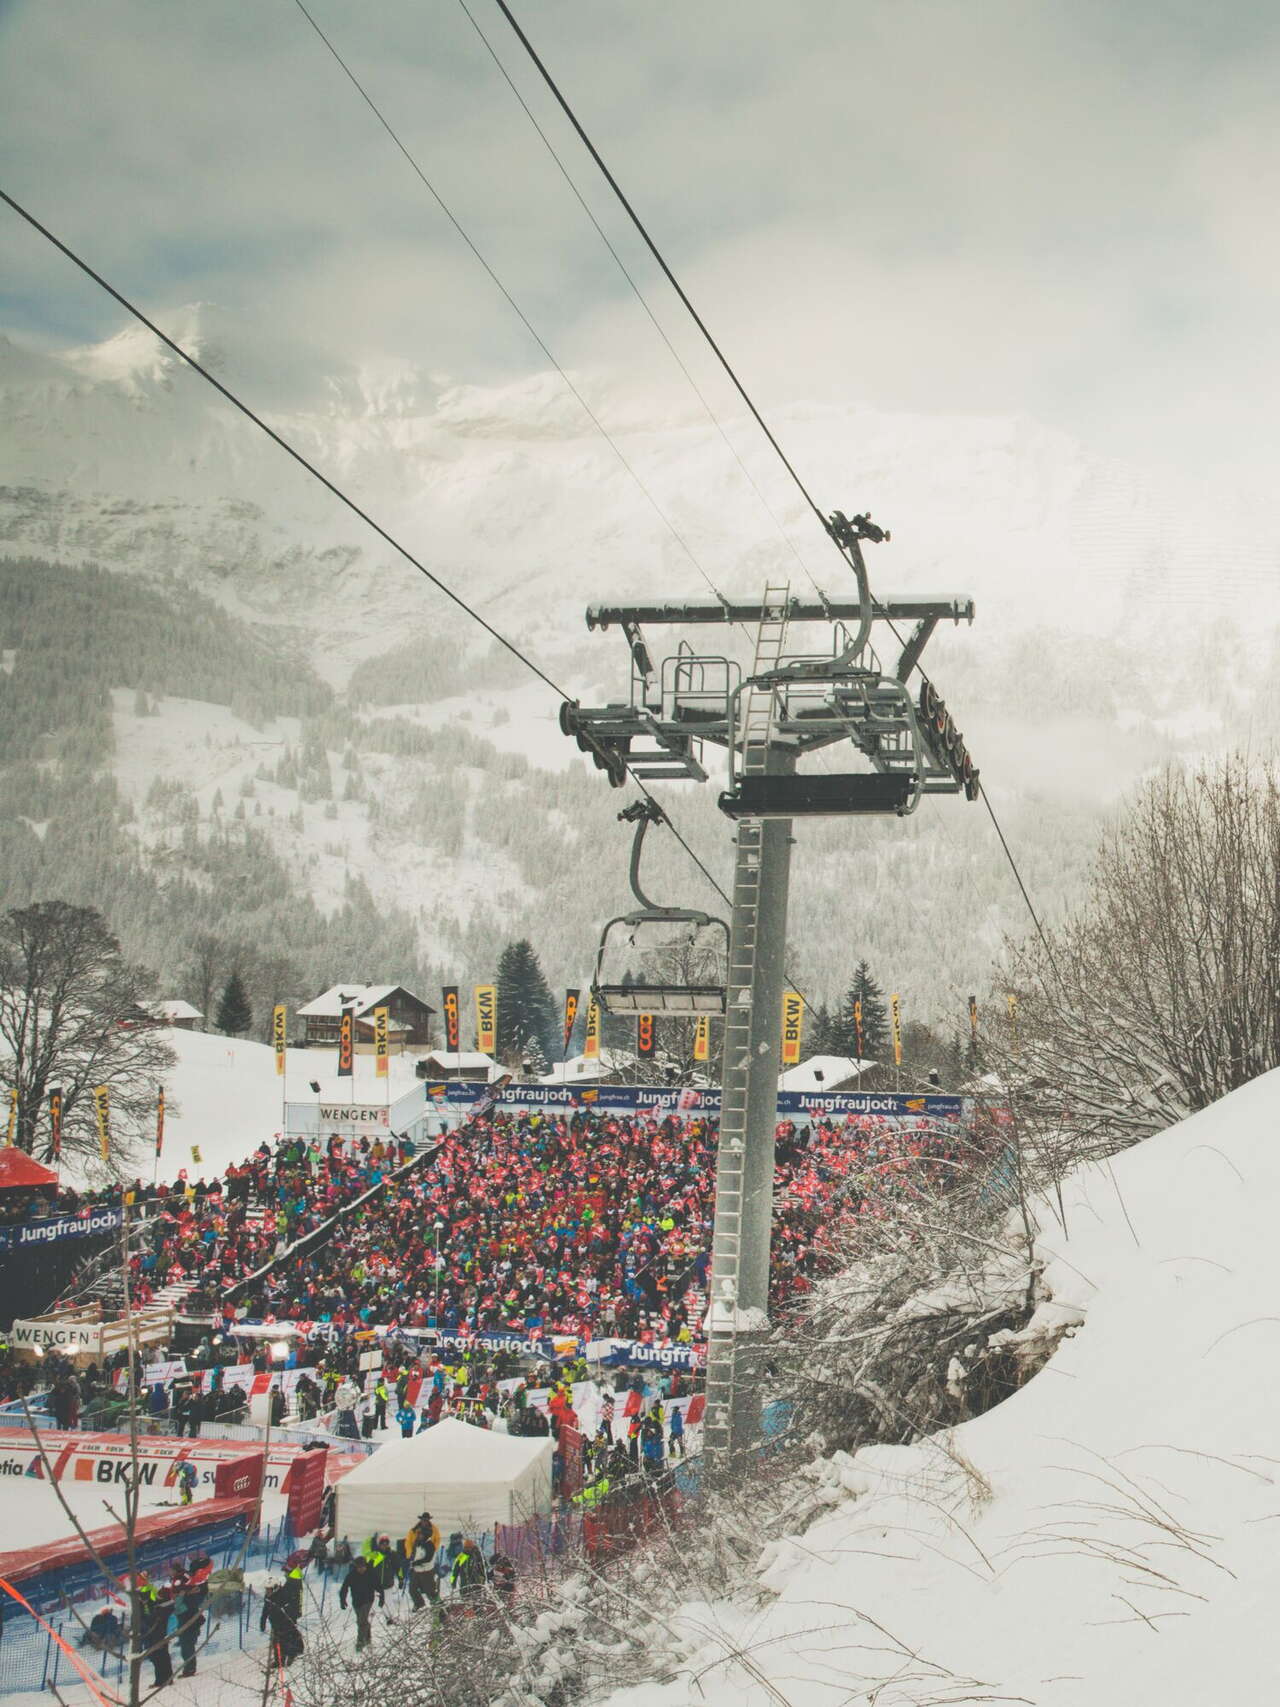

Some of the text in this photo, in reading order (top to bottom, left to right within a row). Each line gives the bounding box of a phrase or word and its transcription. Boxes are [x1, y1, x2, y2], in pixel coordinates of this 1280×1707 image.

[444, 993, 458, 1046] coop
[479, 991, 493, 1032] BKW
[785, 999, 800, 1041] BKW
[340, 1015, 352, 1069] coop
[639, 1013, 654, 1050] coo
[698, 1016, 706, 1038] BK
[320, 1109, 378, 1121] WENGEN
[798, 1095, 898, 1111] Jungfraujoch
[19, 1212, 117, 1242] Jungfraujoch
[16, 1328, 89, 1345] WENGEN
[97, 1460, 158, 1486] BKW
